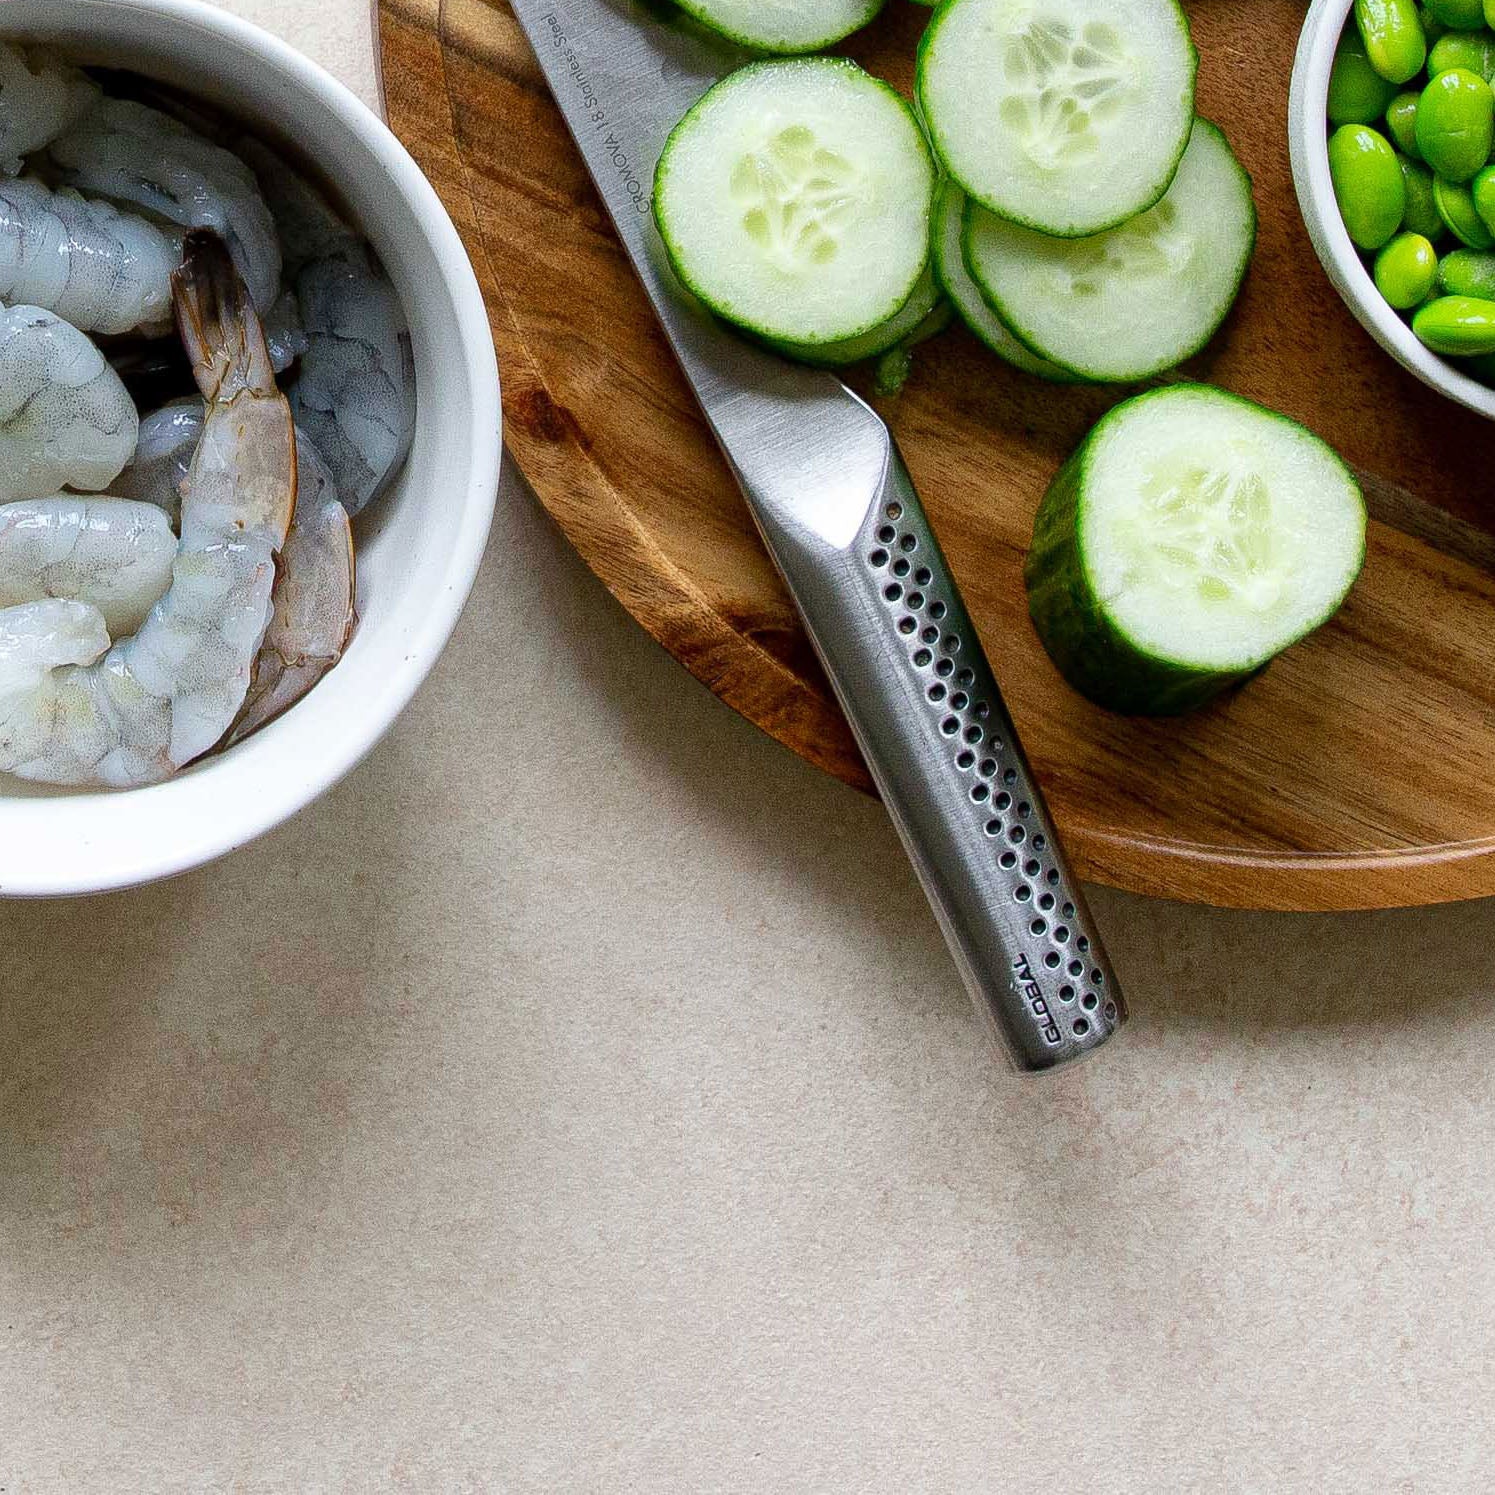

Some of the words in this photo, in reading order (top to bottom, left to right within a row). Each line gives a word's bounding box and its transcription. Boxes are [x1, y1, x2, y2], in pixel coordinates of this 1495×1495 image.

[540, 12, 567, 48] Steel
[565, 47, 598, 109] Stainless
[591, 110, 609, 130] 18
[603, 132, 650, 214] CROMOVA
[1014, 952, 1061, 1043] GLOBAL
